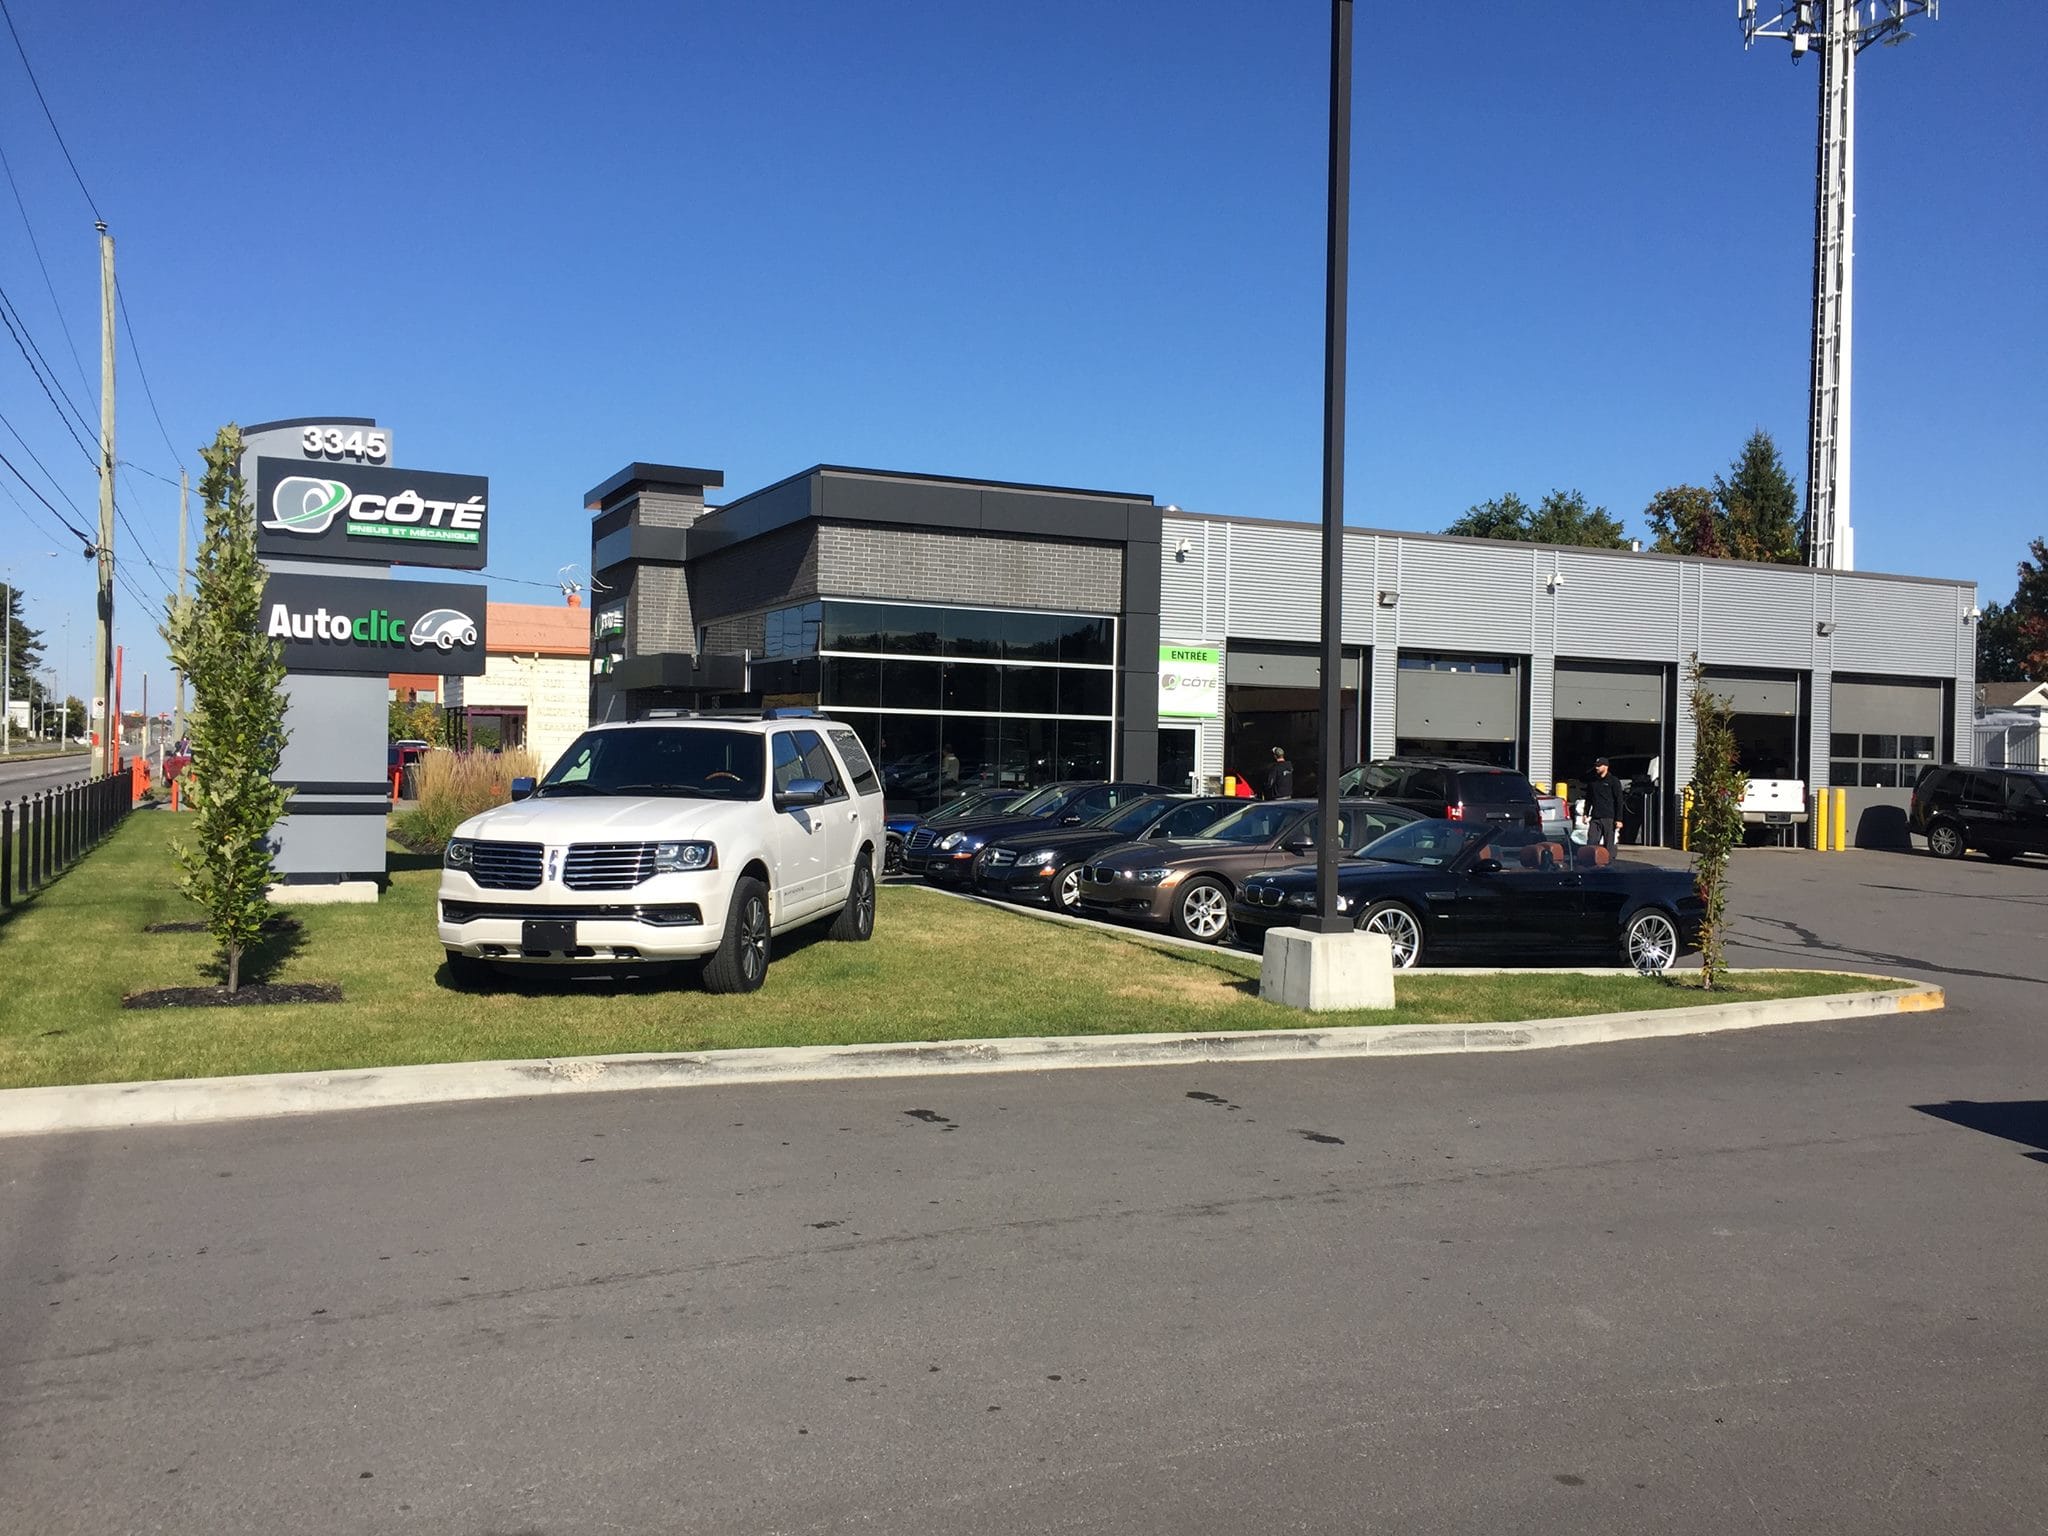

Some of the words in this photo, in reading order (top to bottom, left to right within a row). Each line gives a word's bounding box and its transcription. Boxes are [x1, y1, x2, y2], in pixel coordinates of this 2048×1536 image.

[302, 426, 387, 458] 3345
[349, 489, 486, 530] CÔTÉ
[349, 524, 390, 536] PNEUS
[392, 527, 407, 536] ET
[409, 528, 478, 542] MÉCANIQUE
[267, 603, 406, 643] Autoclic
[1171, 650, 1208, 661] ENTRÉE
[1181, 676, 1217, 689] CÔTÉ
